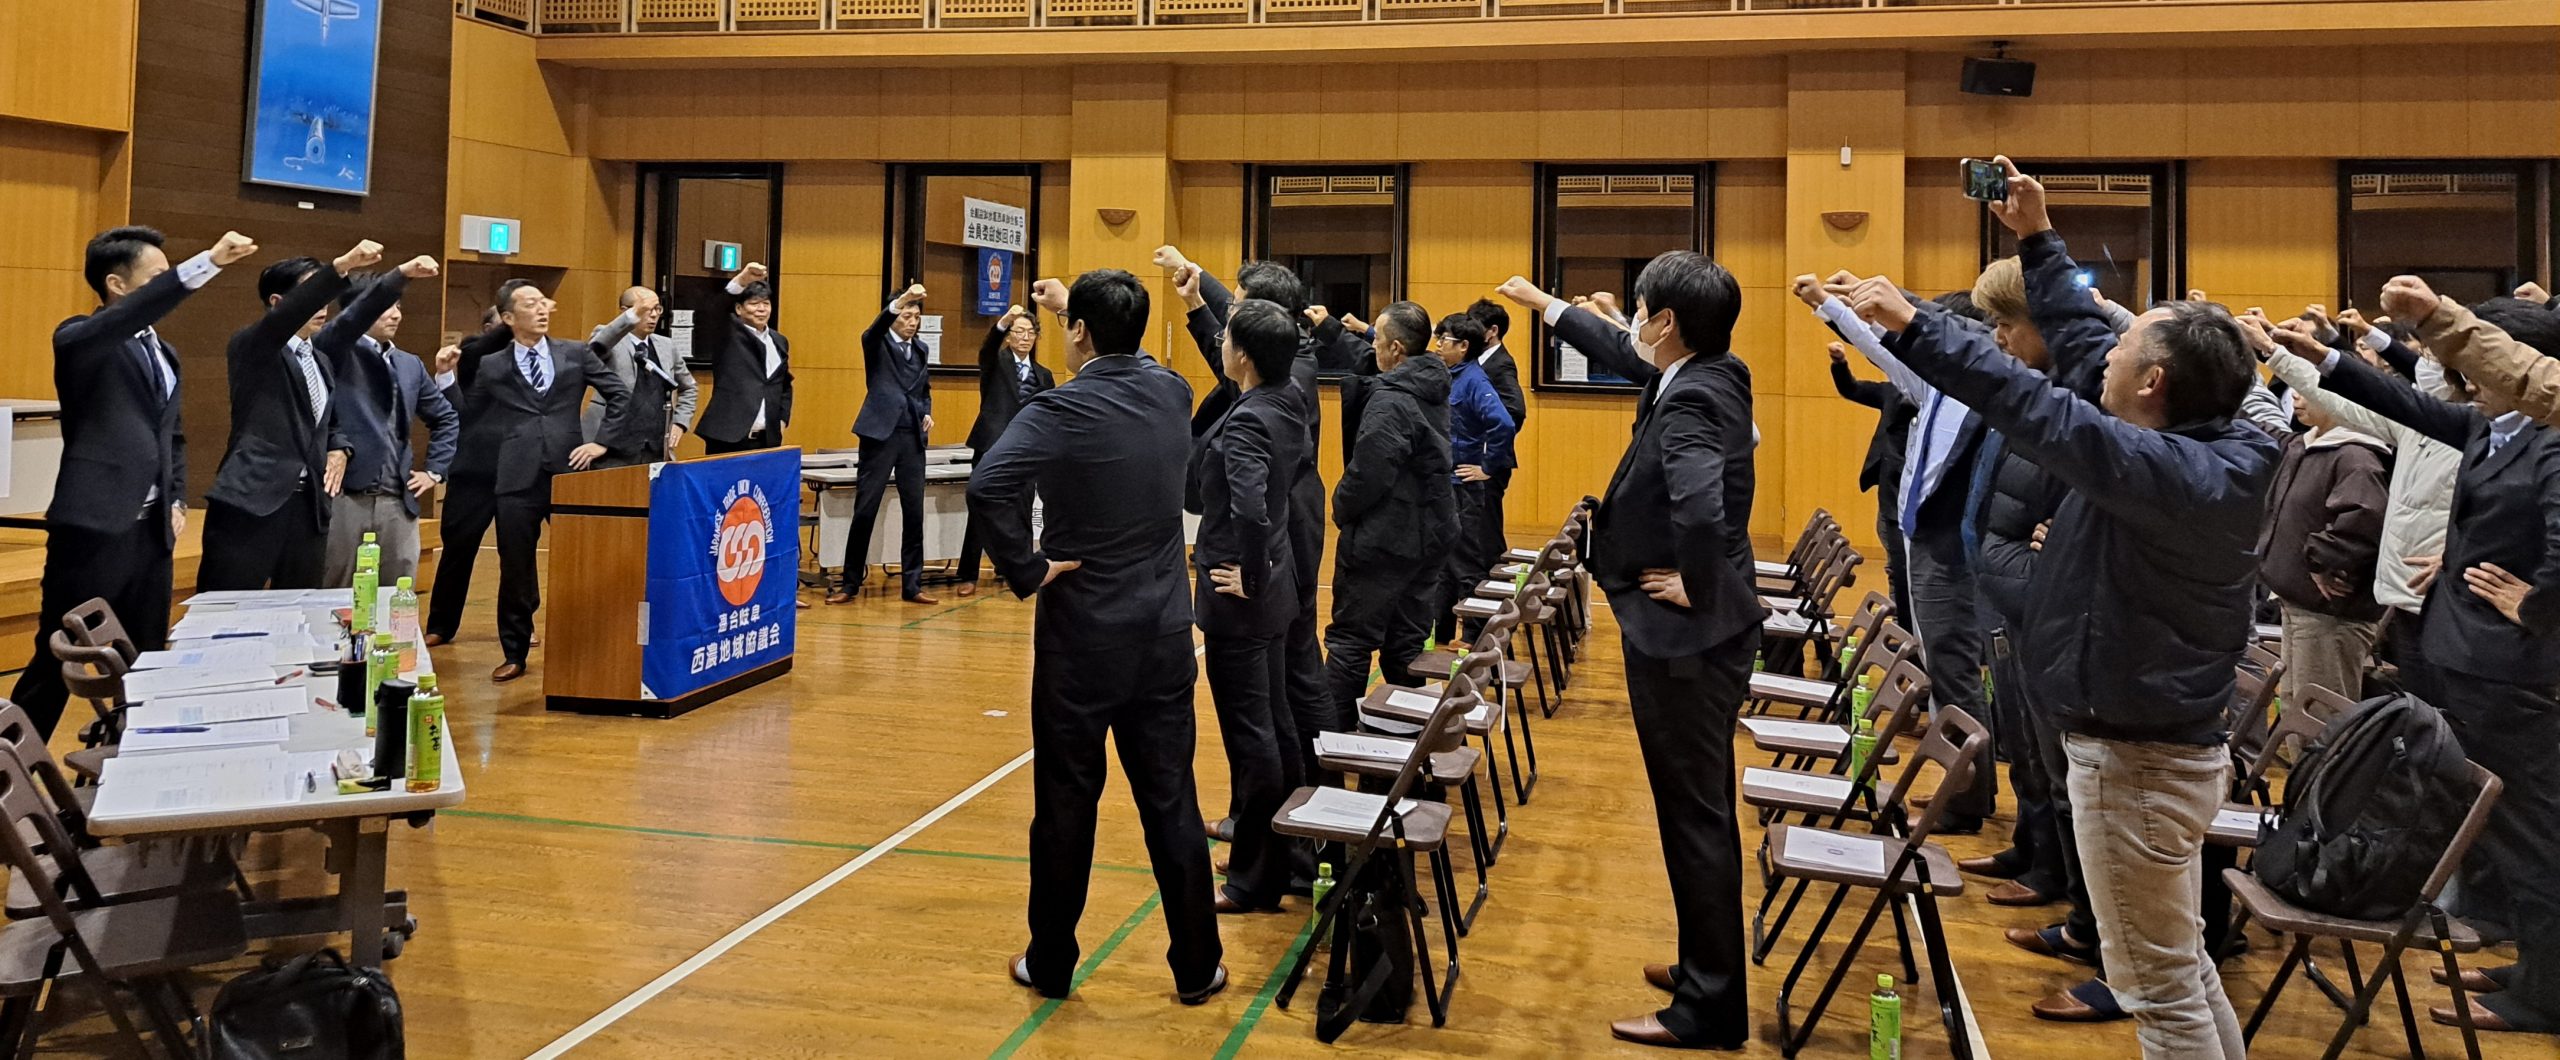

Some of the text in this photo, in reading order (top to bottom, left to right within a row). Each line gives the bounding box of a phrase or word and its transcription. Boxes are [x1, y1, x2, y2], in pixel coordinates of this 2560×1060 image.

[718, 604, 760, 633] 連合岐阜
[691, 622, 780, 675] 西濃地域協議会
